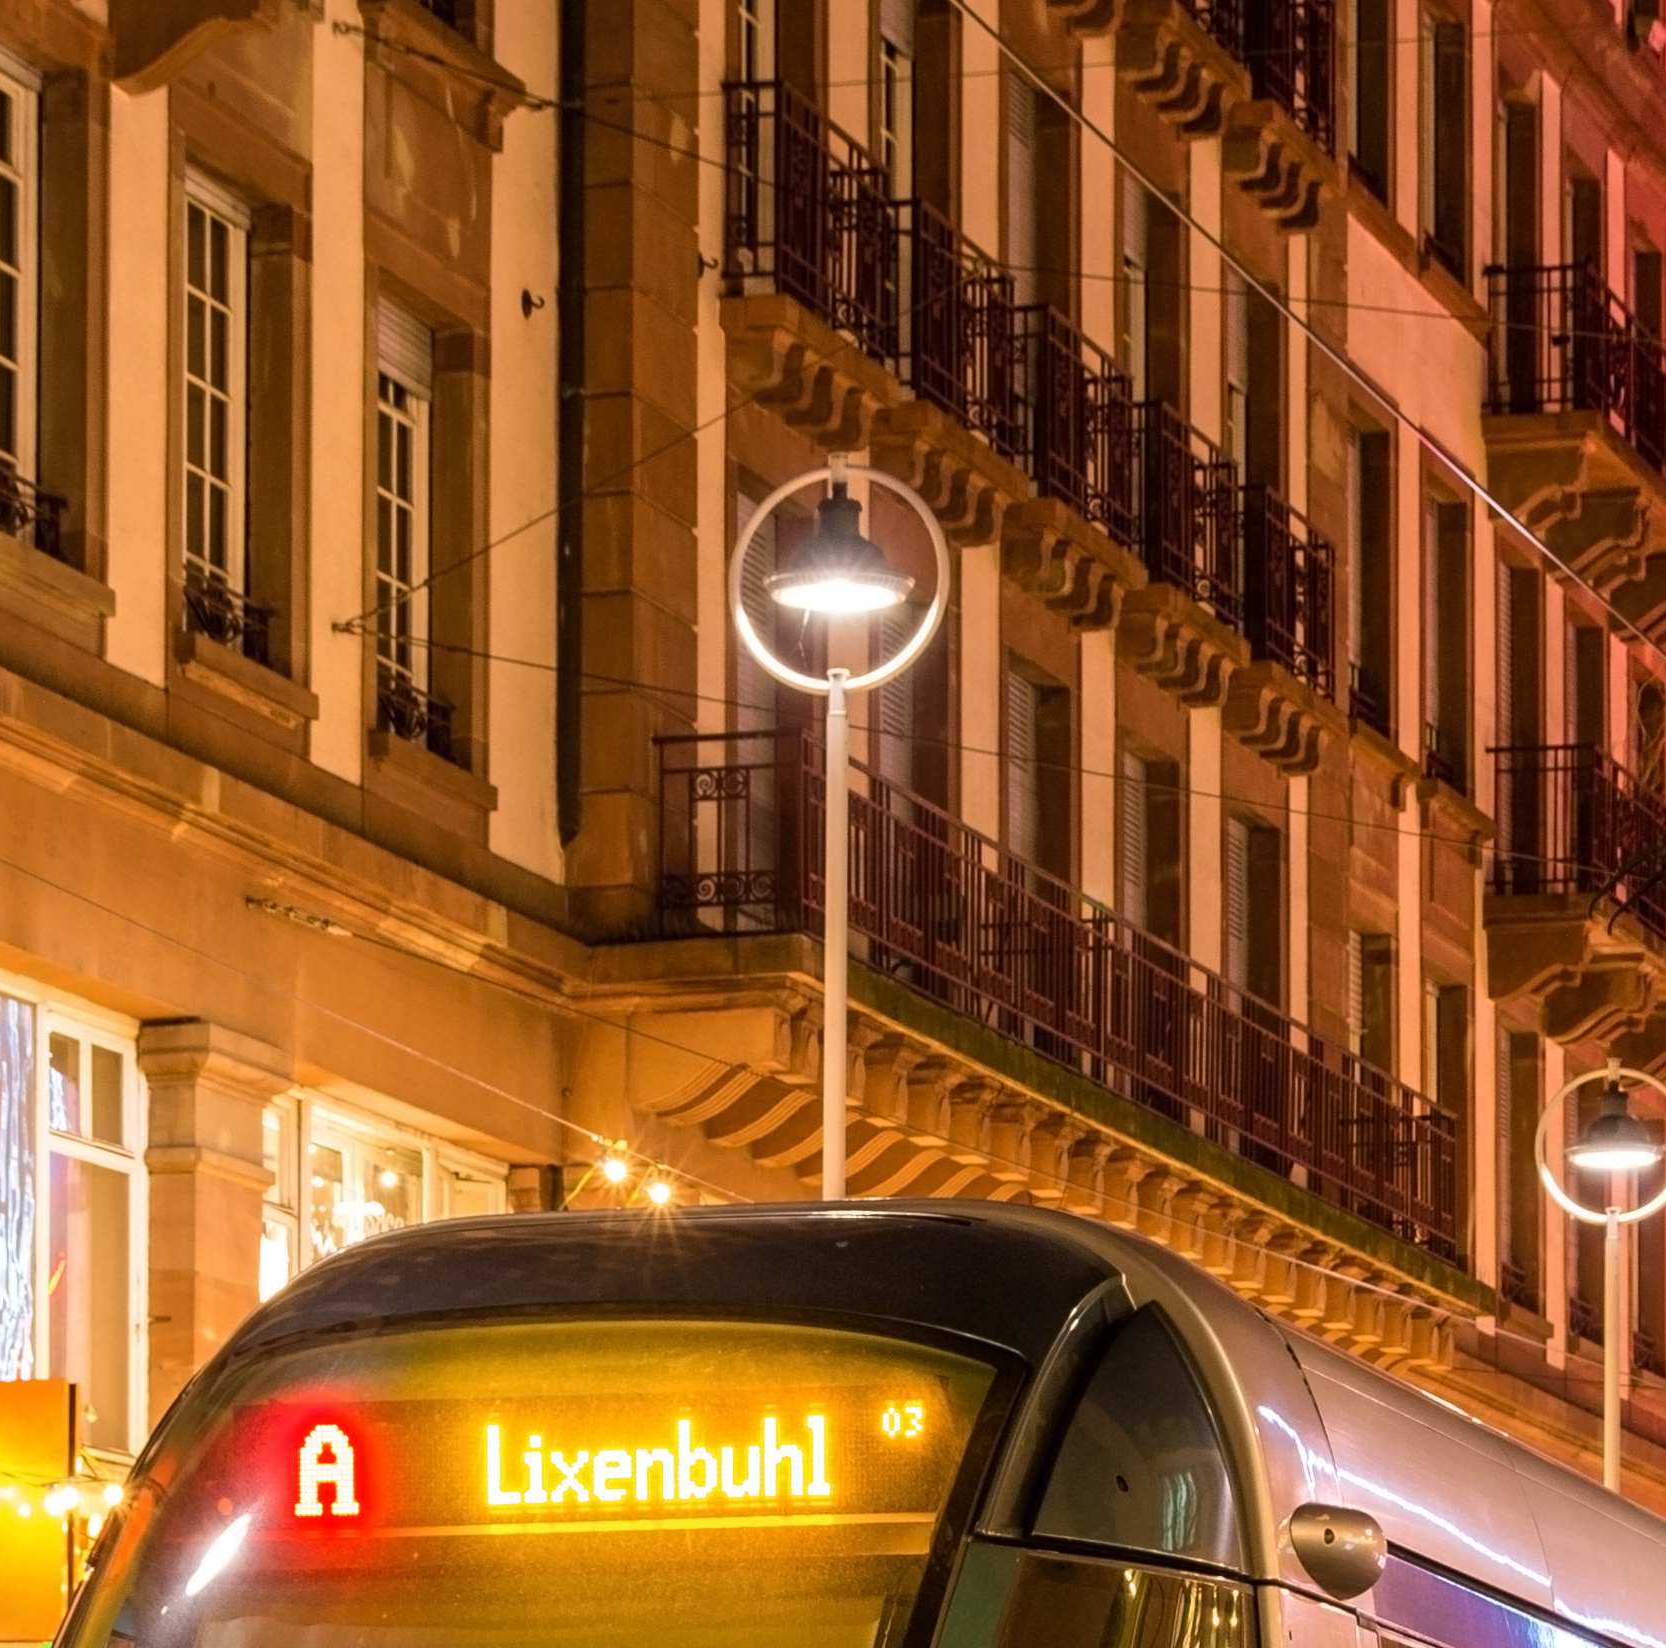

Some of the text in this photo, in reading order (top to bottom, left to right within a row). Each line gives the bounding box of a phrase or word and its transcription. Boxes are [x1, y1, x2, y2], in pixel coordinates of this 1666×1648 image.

[294, 1406, 923, 1518] A Lixenbuhl 03
